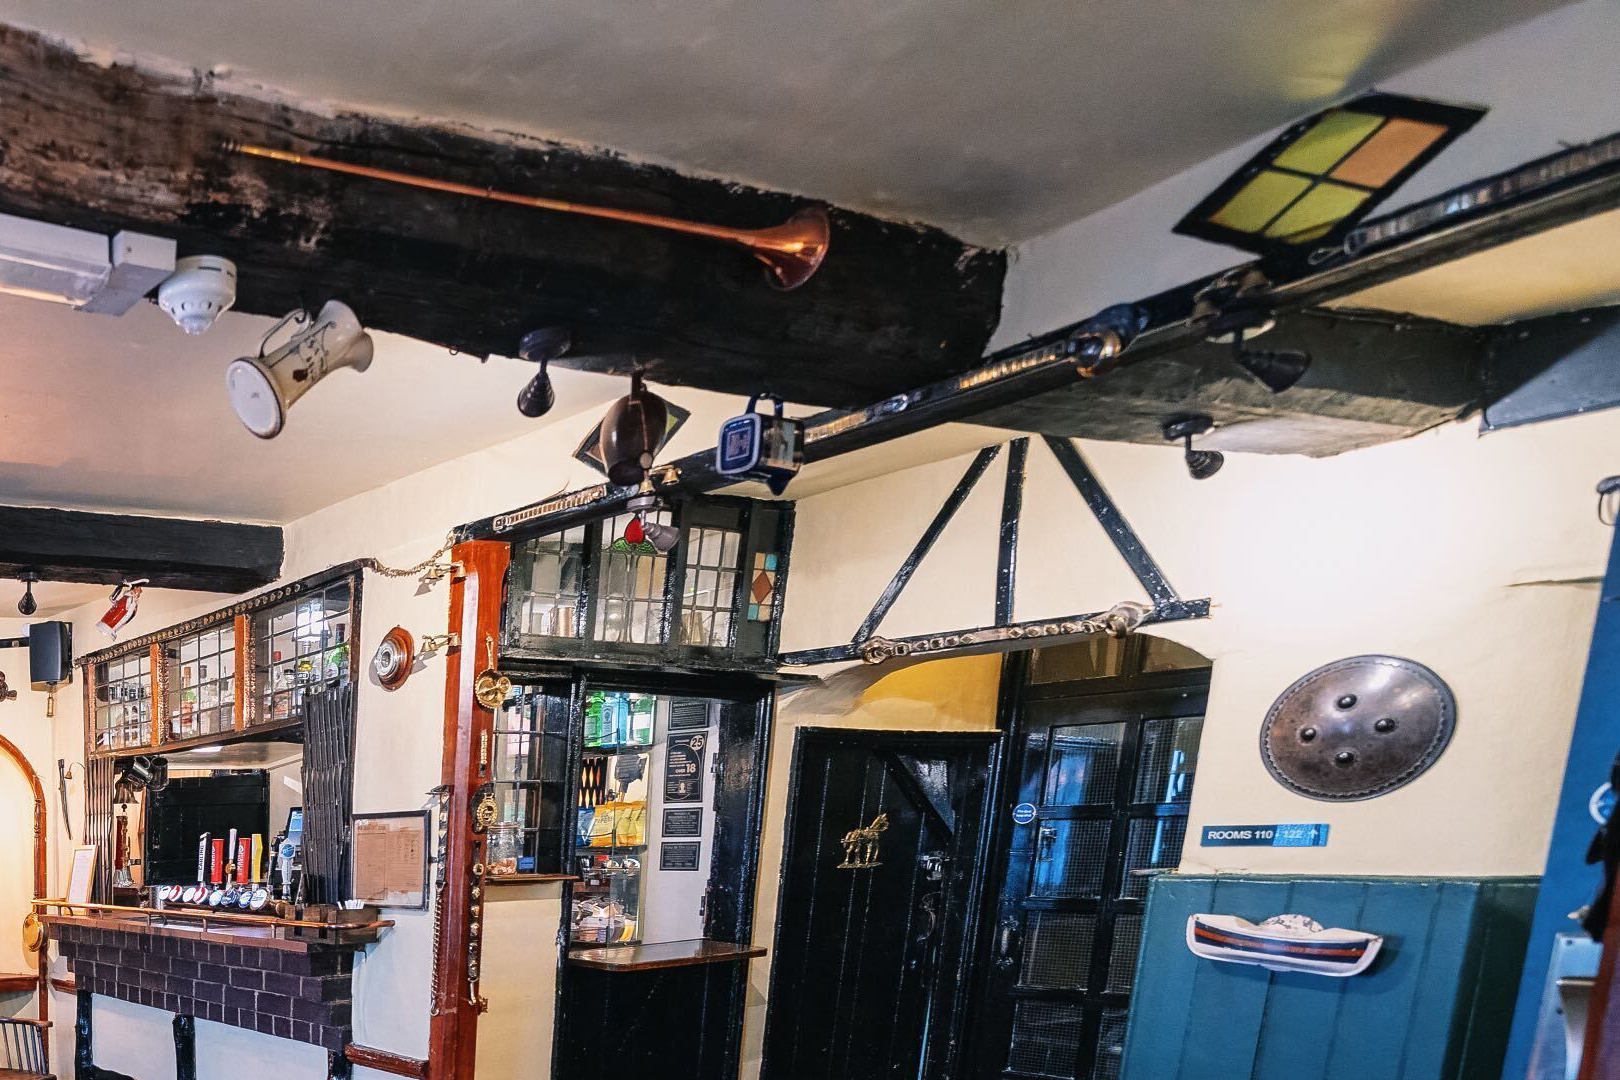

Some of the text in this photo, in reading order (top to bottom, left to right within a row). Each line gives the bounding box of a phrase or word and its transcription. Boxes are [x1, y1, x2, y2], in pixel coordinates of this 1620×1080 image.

[691, 738, 703, 748] 25
[686, 763, 696, 773] 18
[1207, 830, 1252, 840] ROOMS
[1254, 830, 1273, 839] 110
